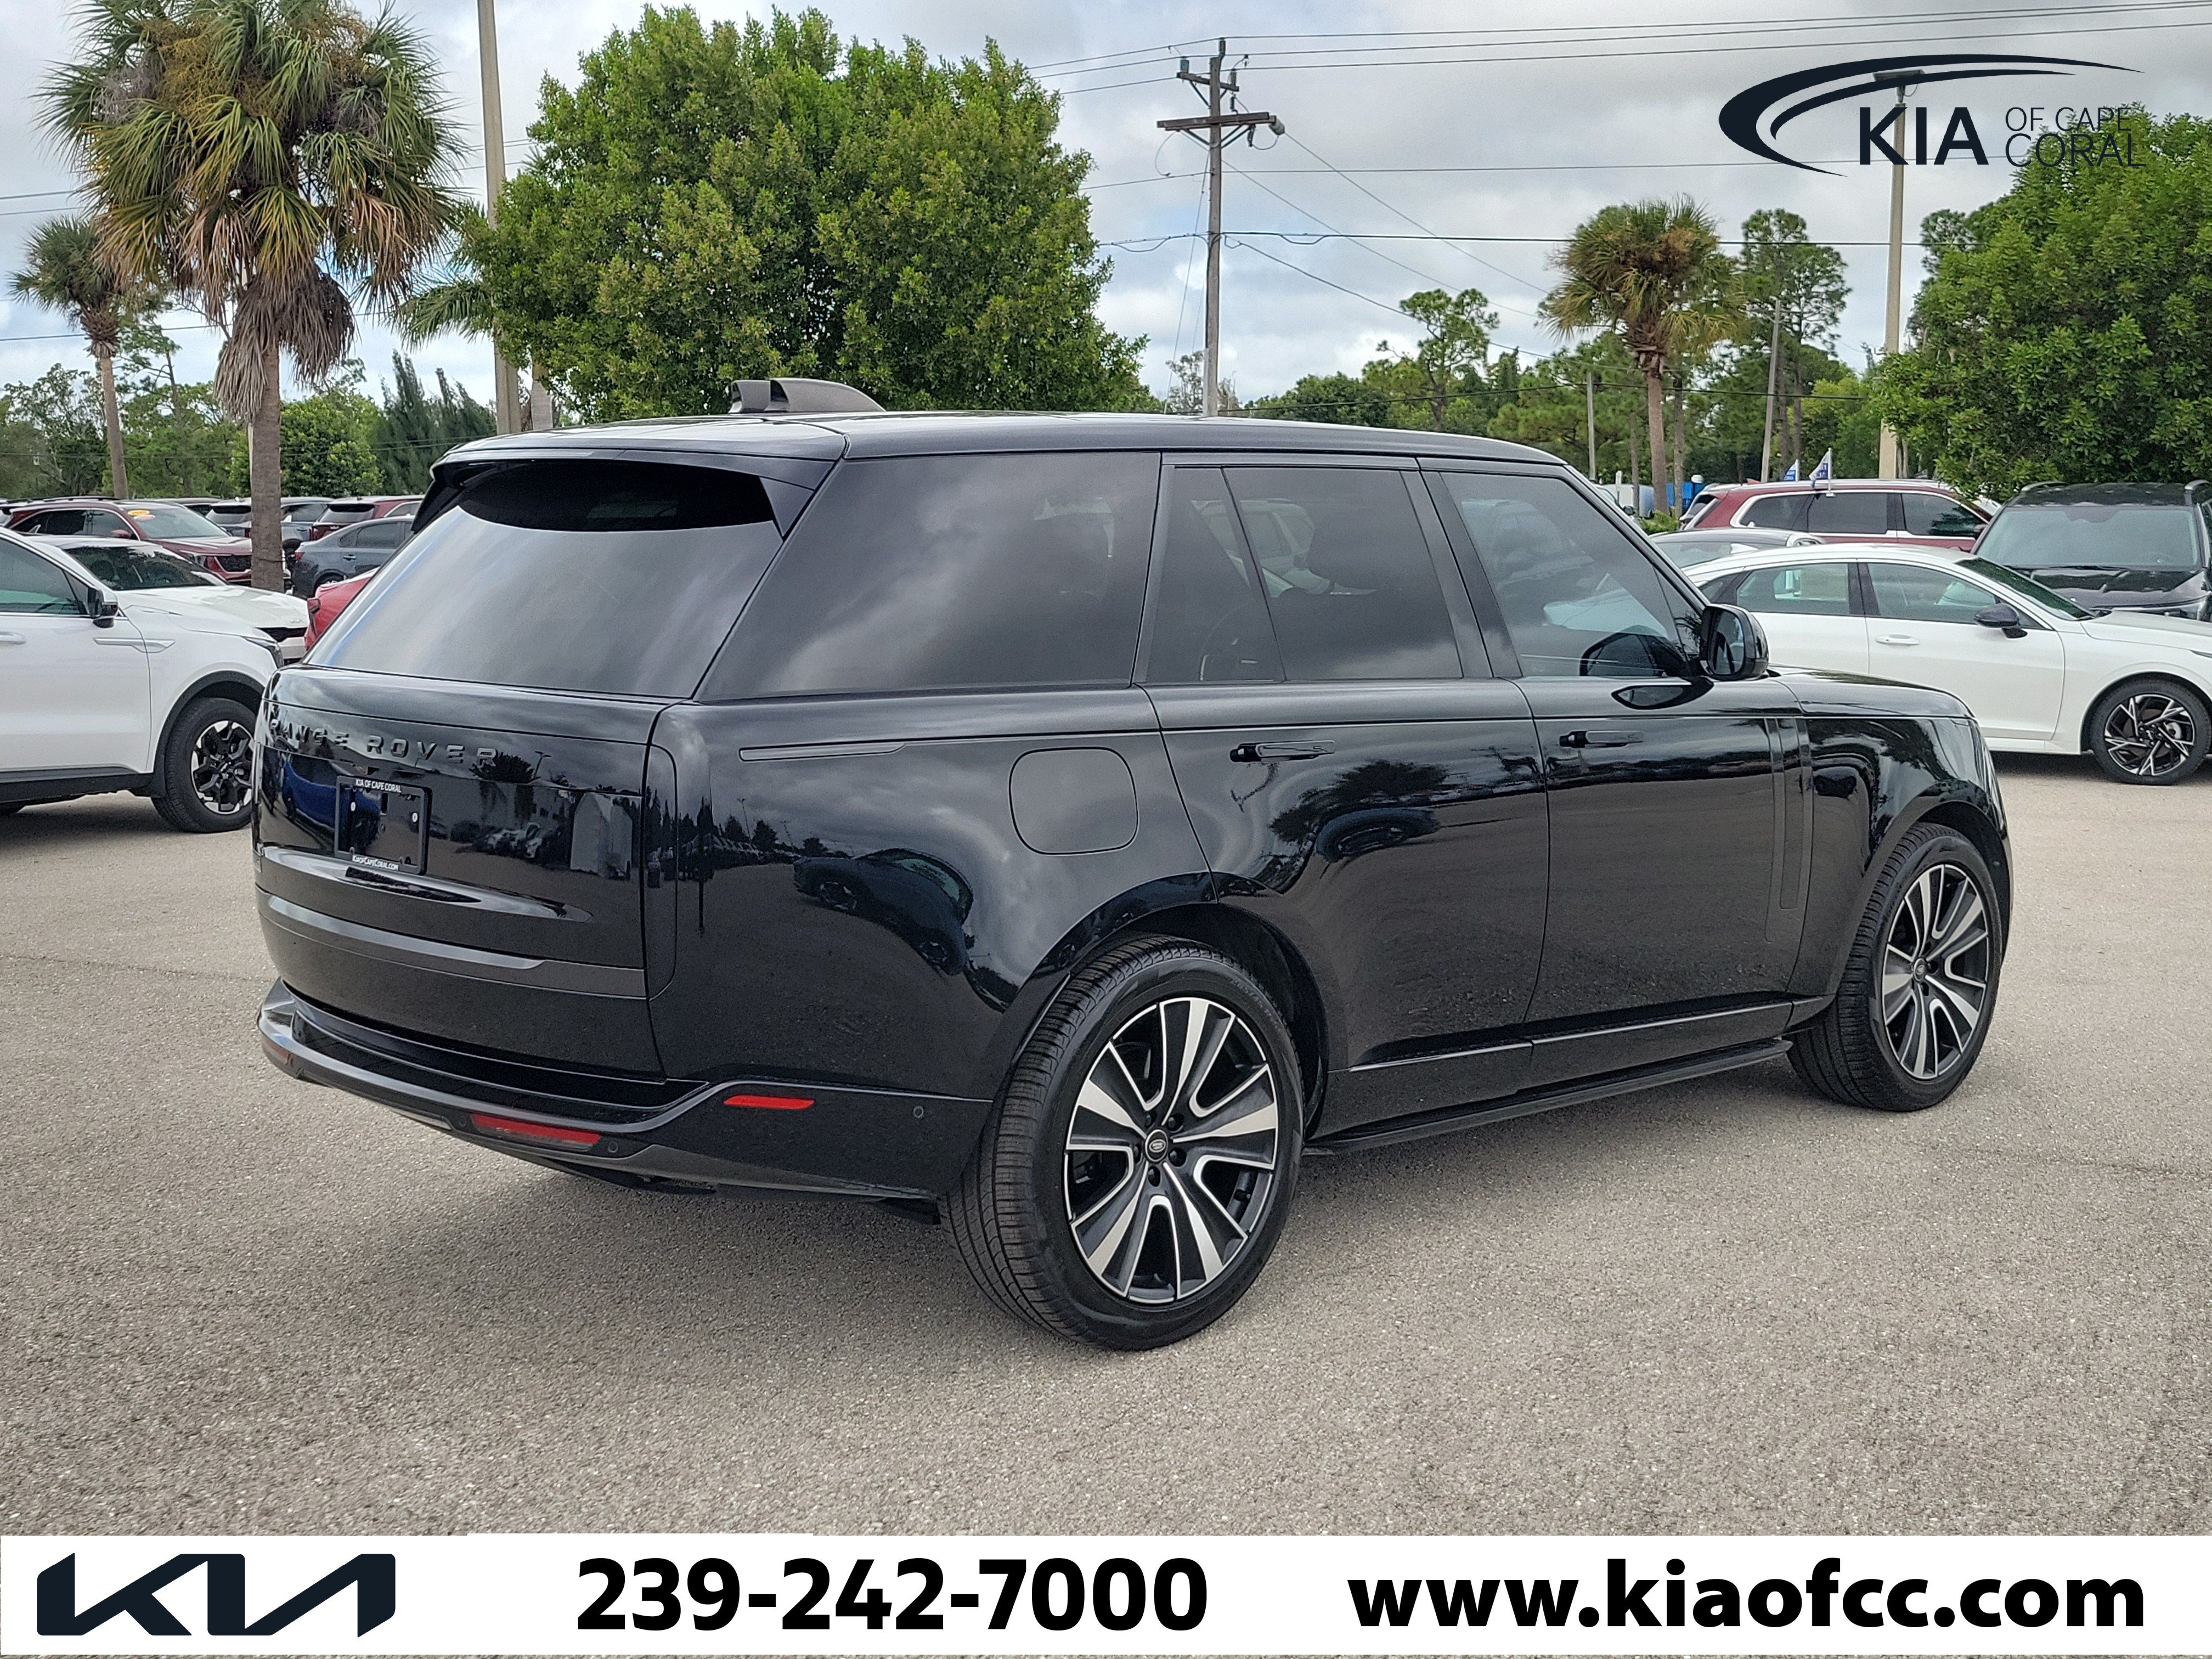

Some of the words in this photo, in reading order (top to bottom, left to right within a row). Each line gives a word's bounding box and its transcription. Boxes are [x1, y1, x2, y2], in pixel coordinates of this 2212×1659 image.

[270, 718, 350, 750] RANGE
[367, 735, 498, 769] ROVER
[356, 778, 364, 787] KIA
[364, 780, 372, 788] OF
[371, 781, 385, 791] CAPE
[385, 783, 402, 793] CORAL
